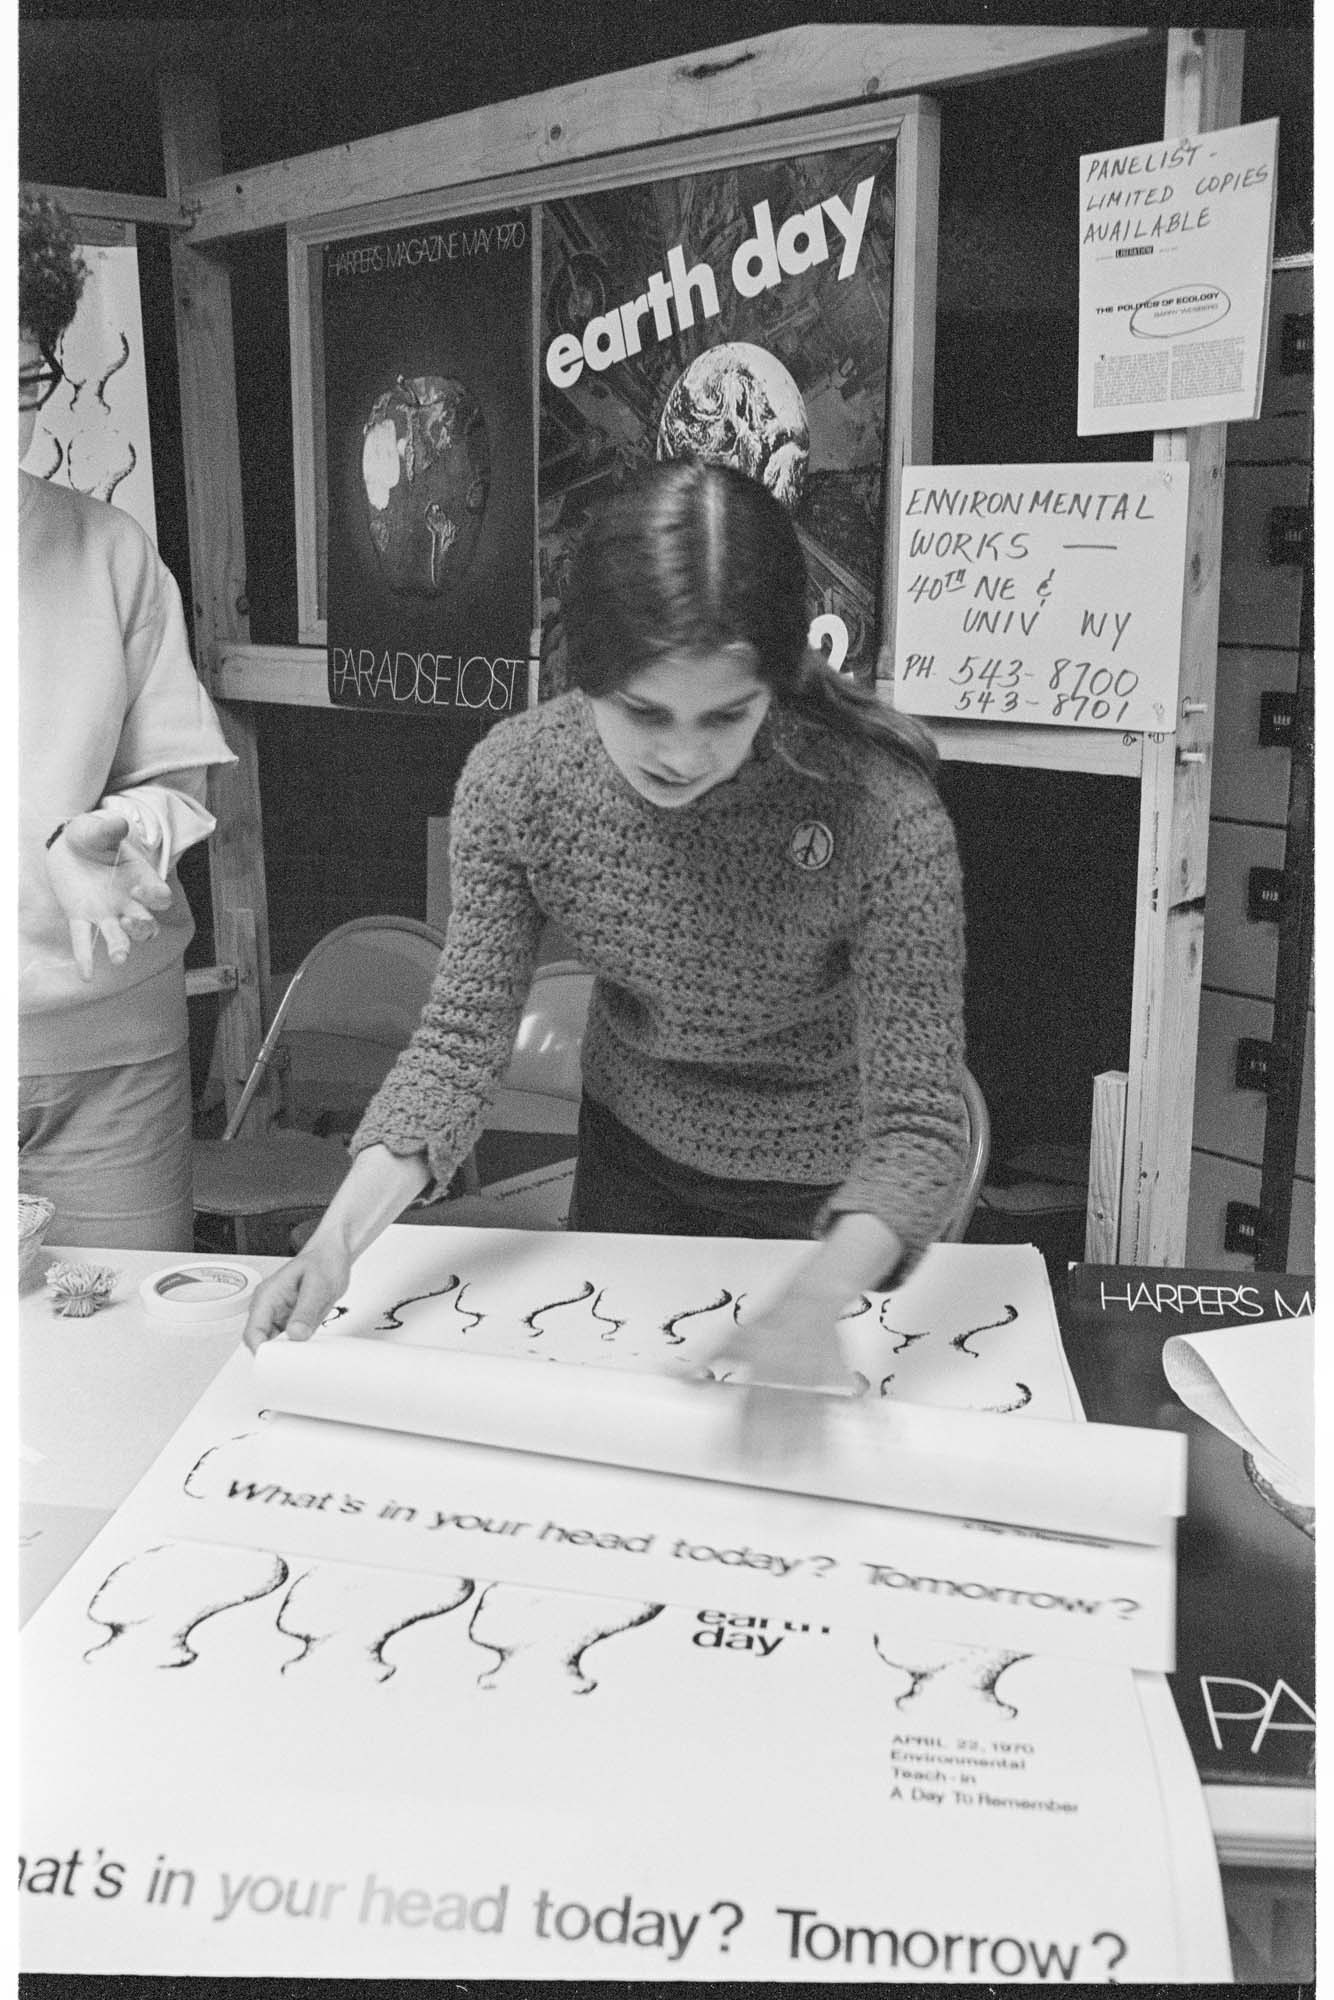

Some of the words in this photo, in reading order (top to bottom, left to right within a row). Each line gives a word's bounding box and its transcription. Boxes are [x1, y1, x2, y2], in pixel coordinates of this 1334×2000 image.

[1086, 144, 1202, 183] PANELIST
[1086, 184, 1174, 212] LIMITED
[1195, 164, 1268, 196] COPIES
[1083, 206, 1211, 244] AVAILABLE
[545, 244, 720, 389] earth
[731, 175, 876, 299] day
[1096, 305, 1113, 315] THE
[1161, 298, 1174, 307] OF
[1176, 291, 1220, 305] ECOLOGY
[905, 488, 1155, 521] ENVIRONMENTAL
[909, 529, 1031, 563] WORKS
[974, 575, 1016, 602] NE
[962, 607, 1040, 637] UNIV
[1080, 609, 1132, 652] WY
[333, 648, 453, 705] PARADISE
[455, 656, 525, 711] LOST
[902, 654, 935, 681] PH
[1100, 1281, 1264, 1317] HARPER'S
[226, 1479, 366, 1515] What's
[376, 1499, 418, 1523] in
[426, 1510, 531, 1531] your
[536, 1520, 655, 1555] head
[692, 1626, 786, 1657] day
[891, 1750, 1026, 1770] Environmental
[892, 1734, 943, 1747] APRIL
[991, 1741, 1035, 1753] 1970
[890, 1786, 903, 1799] A
[911, 1787, 944, 1804] Day
[953, 1790, 974, 1805] To
[978, 1792, 1079, 1813] Remember
[18, 1848, 127, 1900] at's
[146, 1854, 197, 1907] in
[212, 1872, 348, 1923] your
[358, 1872, 510, 1934] head
